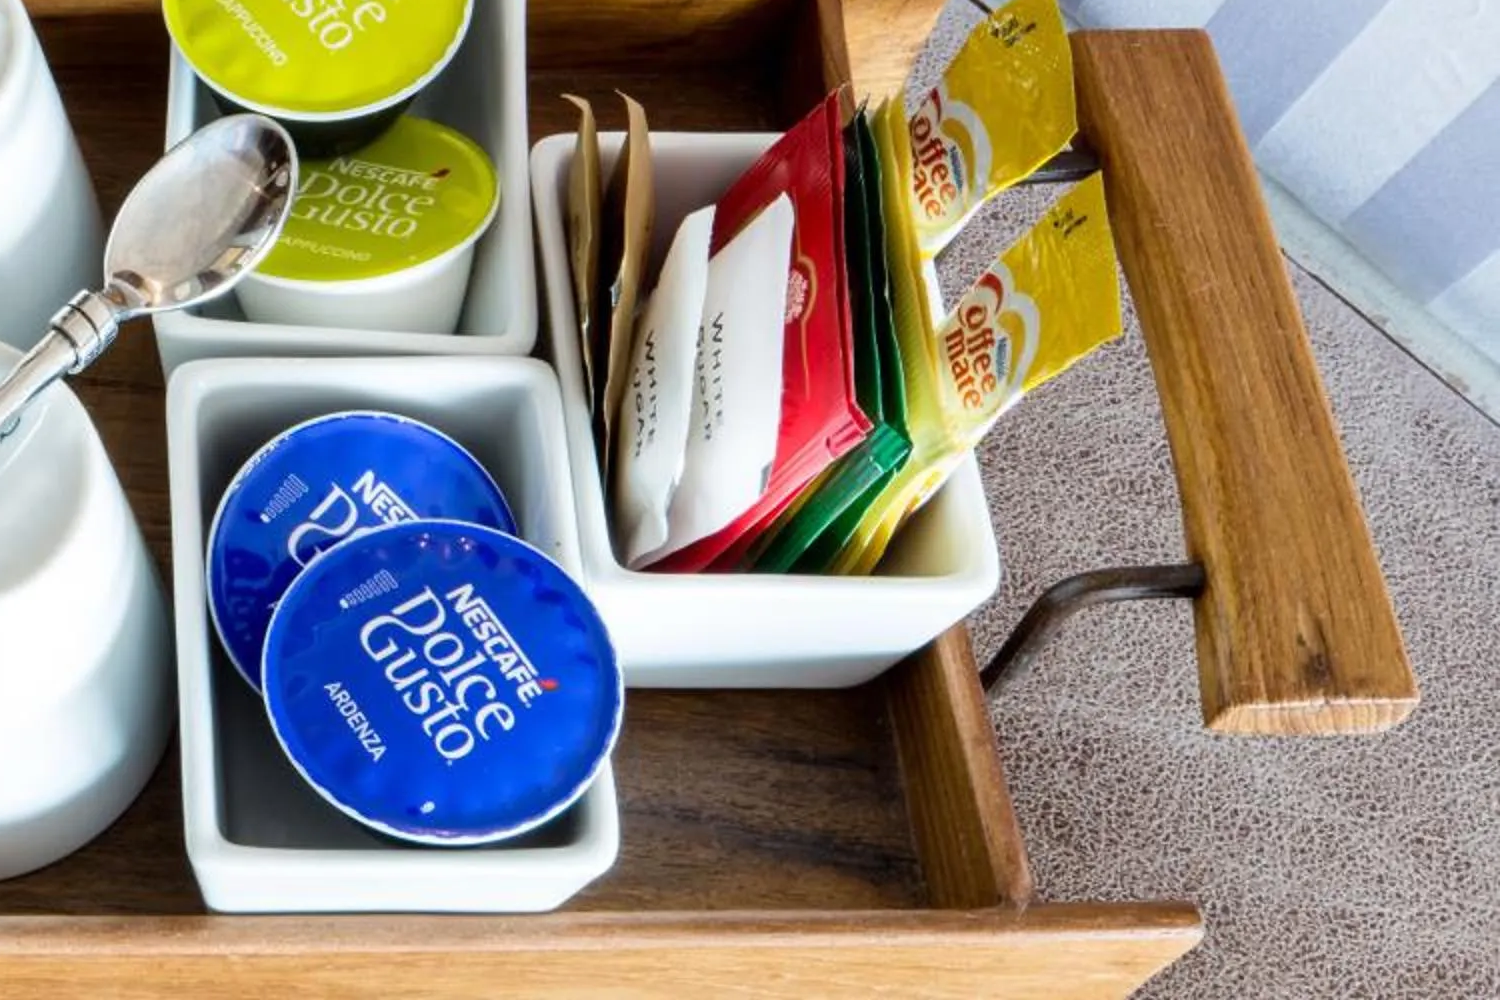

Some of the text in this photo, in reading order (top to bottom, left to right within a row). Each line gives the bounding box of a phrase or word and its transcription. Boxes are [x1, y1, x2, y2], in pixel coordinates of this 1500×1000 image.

[632, 363, 646, 459] UGAR
[645, 329, 658, 446] WHITE
[711, 311, 725, 427] WHITE
[945, 328, 983, 410] mate
[323, 680, 389, 764] ARDENZA
